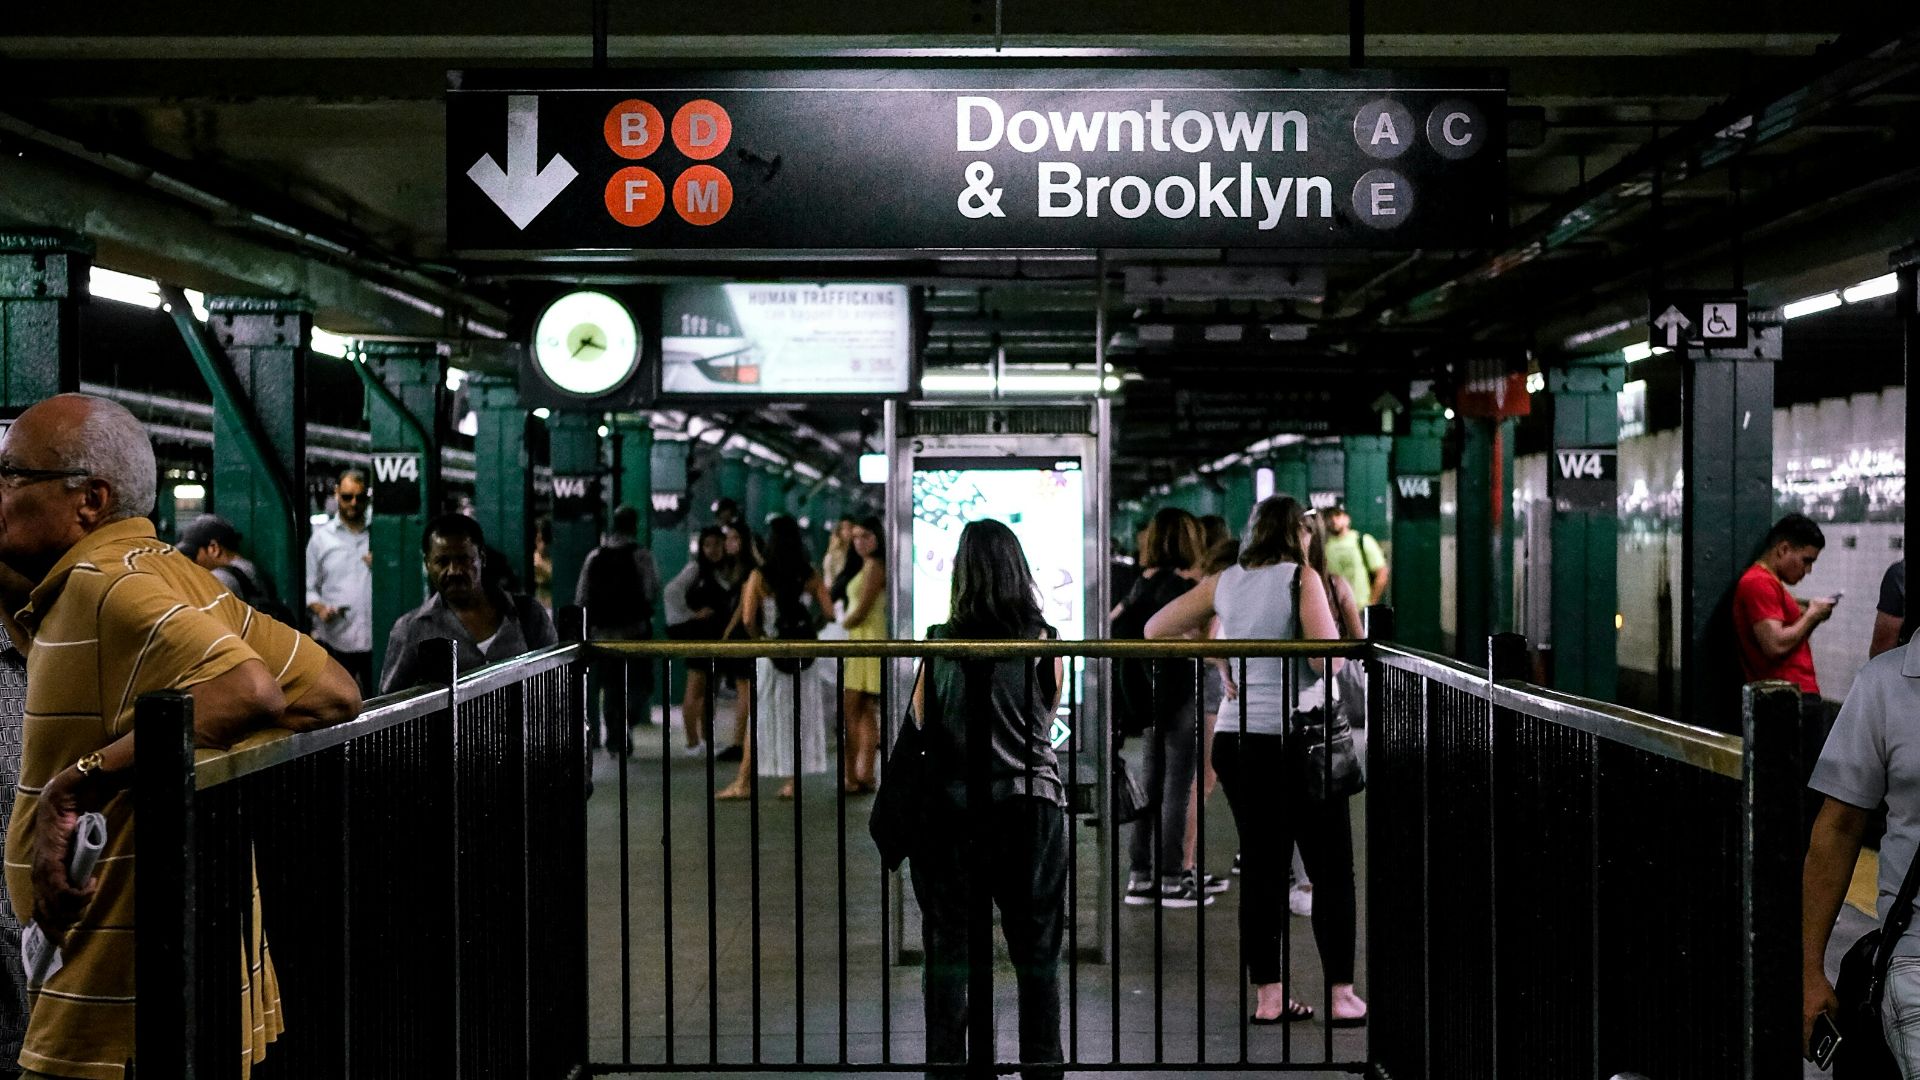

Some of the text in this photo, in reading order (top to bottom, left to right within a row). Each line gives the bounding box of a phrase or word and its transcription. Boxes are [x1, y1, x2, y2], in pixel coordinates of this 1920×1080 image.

[621, 113, 718, 146] B D
[956, 96, 1309, 153] Downtown
[1371, 112, 1473, 146] A C
[625, 180, 718, 213] F M
[957, 161, 1333, 230] & Brooklyn
[1371, 183, 1396, 215] E
[748, 290, 895, 305] HUMAN TRAFFICKING
[375, 455, 419, 482] W4
[1558, 452, 1603, 479] W4
[553, 478, 585, 498] W4
[1397, 479, 1431, 498] W4
